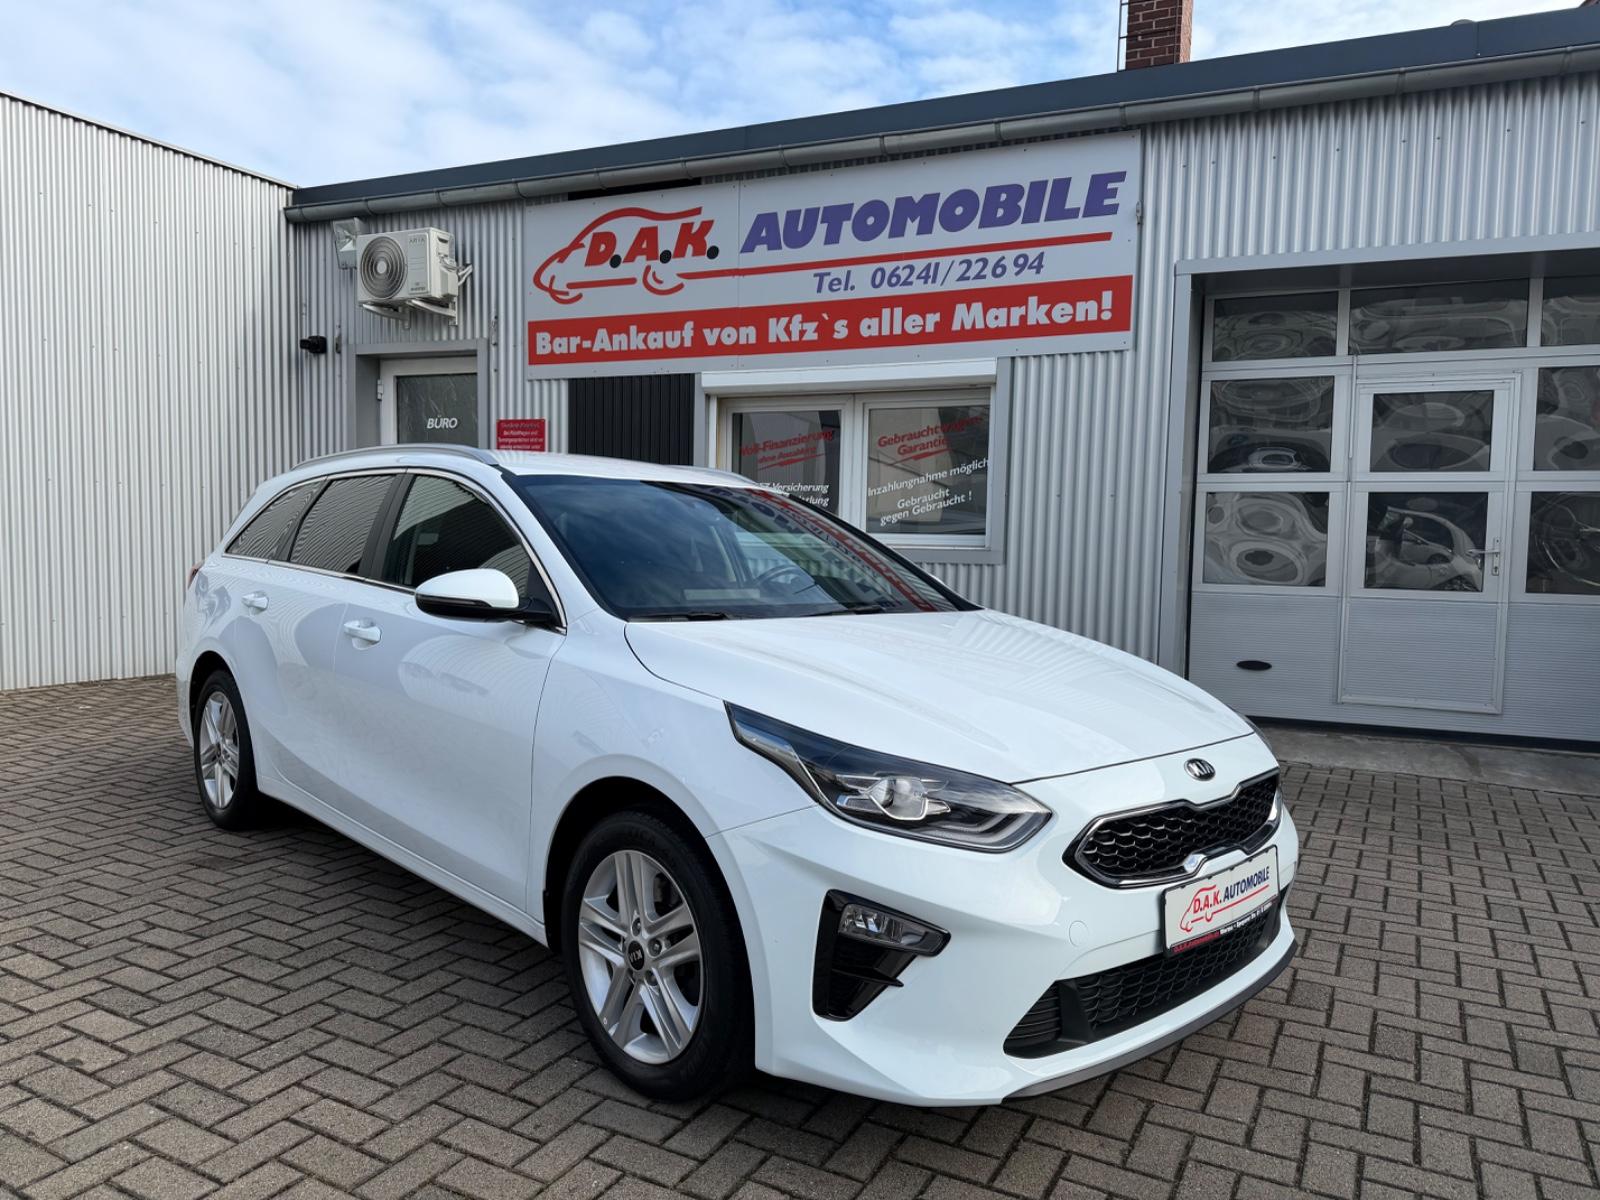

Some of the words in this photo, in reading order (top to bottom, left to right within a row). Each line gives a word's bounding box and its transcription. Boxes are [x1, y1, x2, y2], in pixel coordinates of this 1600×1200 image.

[584, 220, 720, 268] D.A.K.
[740, 171, 1127, 254] AUTOMOBILE
[813, 270, 856, 294] Tel.
[535, 321, 694, 355] Bar-Ankauf
[703, 325, 757, 346] von
[859, 307, 941, 337] aller
[951, 290, 1113, 331] Marken!
[426, 415, 458, 429] BÜRO
[867, 470, 947, 498] Inzahlungnahme
[897, 488, 950, 510] Gebraucht
[880, 509, 909, 527] gegen
[912, 493, 966, 516] Gebraucht
[1193, 888, 1222, 914] D.A.K.
[1223, 866, 1270, 903] AUTOMOBILE
